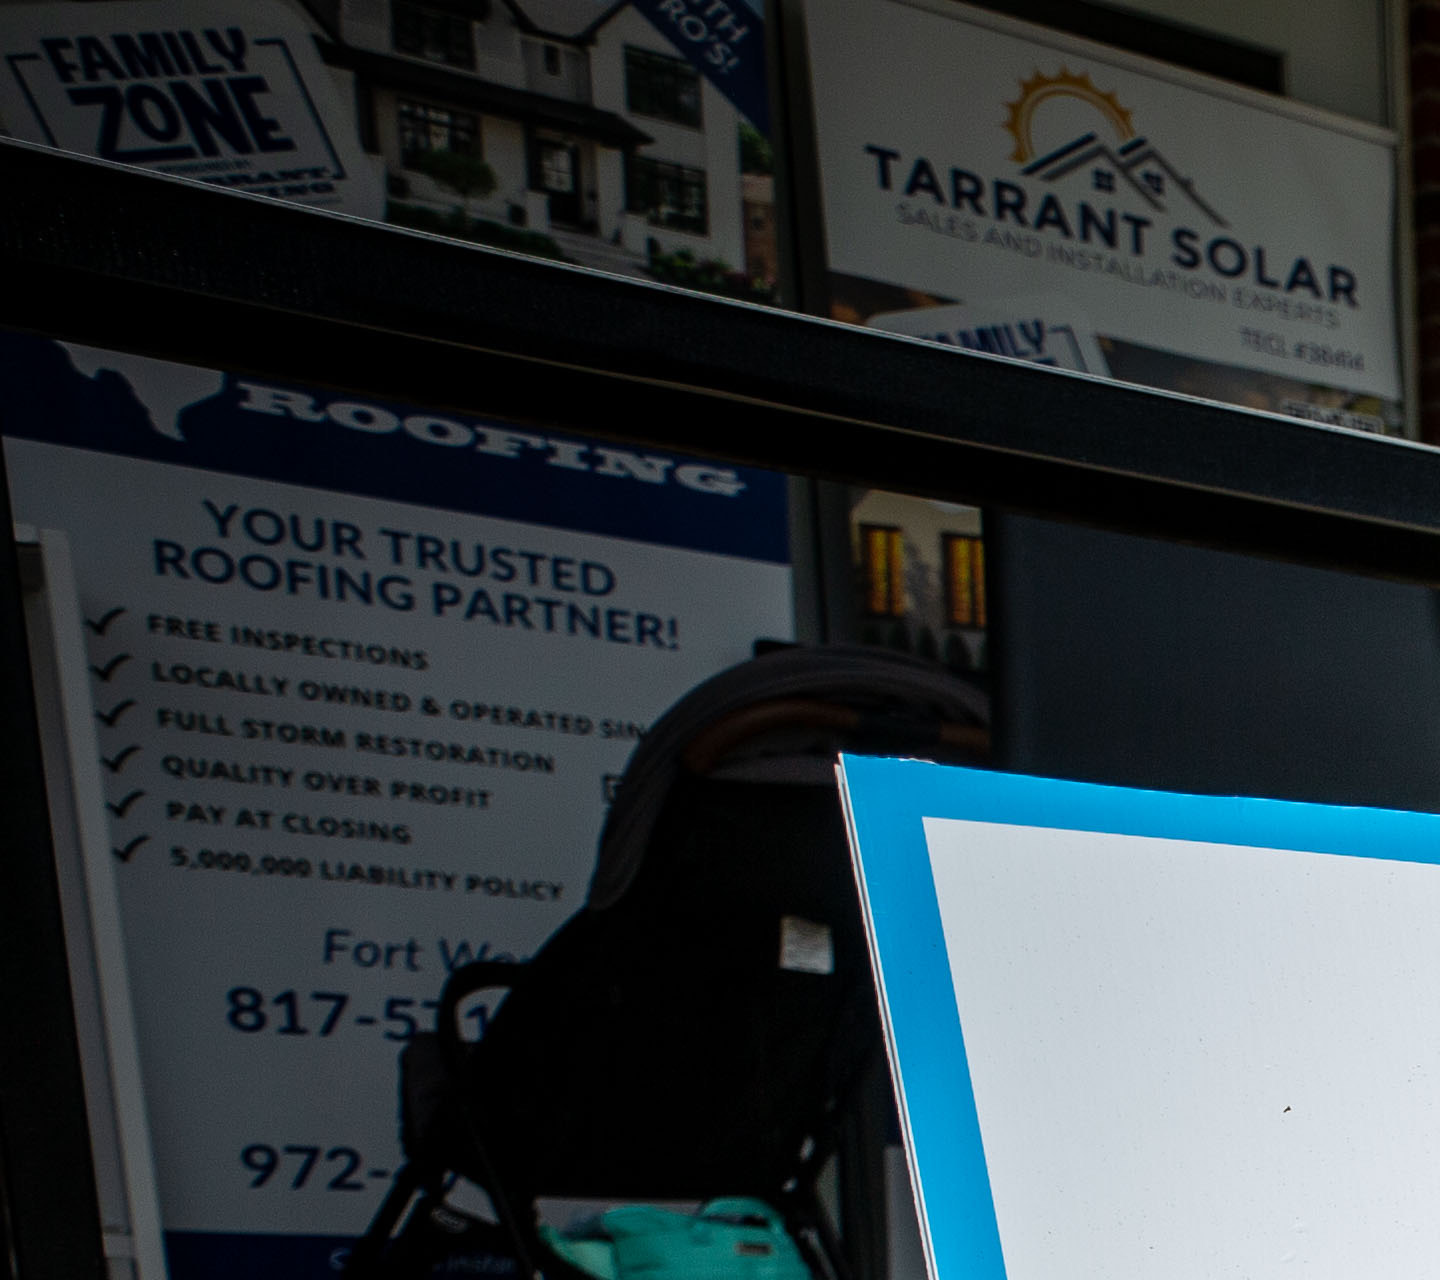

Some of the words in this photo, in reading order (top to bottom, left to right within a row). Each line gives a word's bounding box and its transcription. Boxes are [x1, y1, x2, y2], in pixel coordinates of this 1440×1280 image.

[42, 28, 246, 82] FAMILY
[67, 76, 294, 162] ZONE
[866, 145, 1152, 253] TARRANT
[1171, 226, 1360, 307] SOLAR
[896, 203, 978, 242] SALES
[982, 224, 1042, 258] AND
[1046, 241, 1227, 301] INSTALLATION
[1231, 287, 1339, 328] EXPERTS
[233, 381, 748, 497] ROOFING
[202, 499, 366, 559] YOUR
[381, 528, 616, 598] TRUSTED
[152, 538, 416, 612] ROOFING
[432, 583, 681, 651] PARTNER!
[148, 614, 221, 643] FREE
[231, 627, 430, 671] INSPECTIONS
[151, 660, 288, 697] LOCALLY
[299, 680, 411, 713] OWNED
[421, 697, 441, 716] &
[449, 699, 593, 736] OPERATED
[156, 707, 234, 737] FULL
[242, 719, 346, 749] STORM
[356, 731, 555, 774] RESTORATION
[161, 754, 294, 789] QUALITY
[303, 770, 382, 797] OVER
[390, 780, 494, 809] PROFIT
[167, 801, 224, 826] PAY
[235, 809, 272, 831] AT
[281, 814, 413, 846] CLOSING
[169, 846, 312, 878] 5,000,000
[320, 862, 455, 893] LIABILITY
[465, 876, 566, 903] POLICY
[323, 929, 421, 972] Fort
